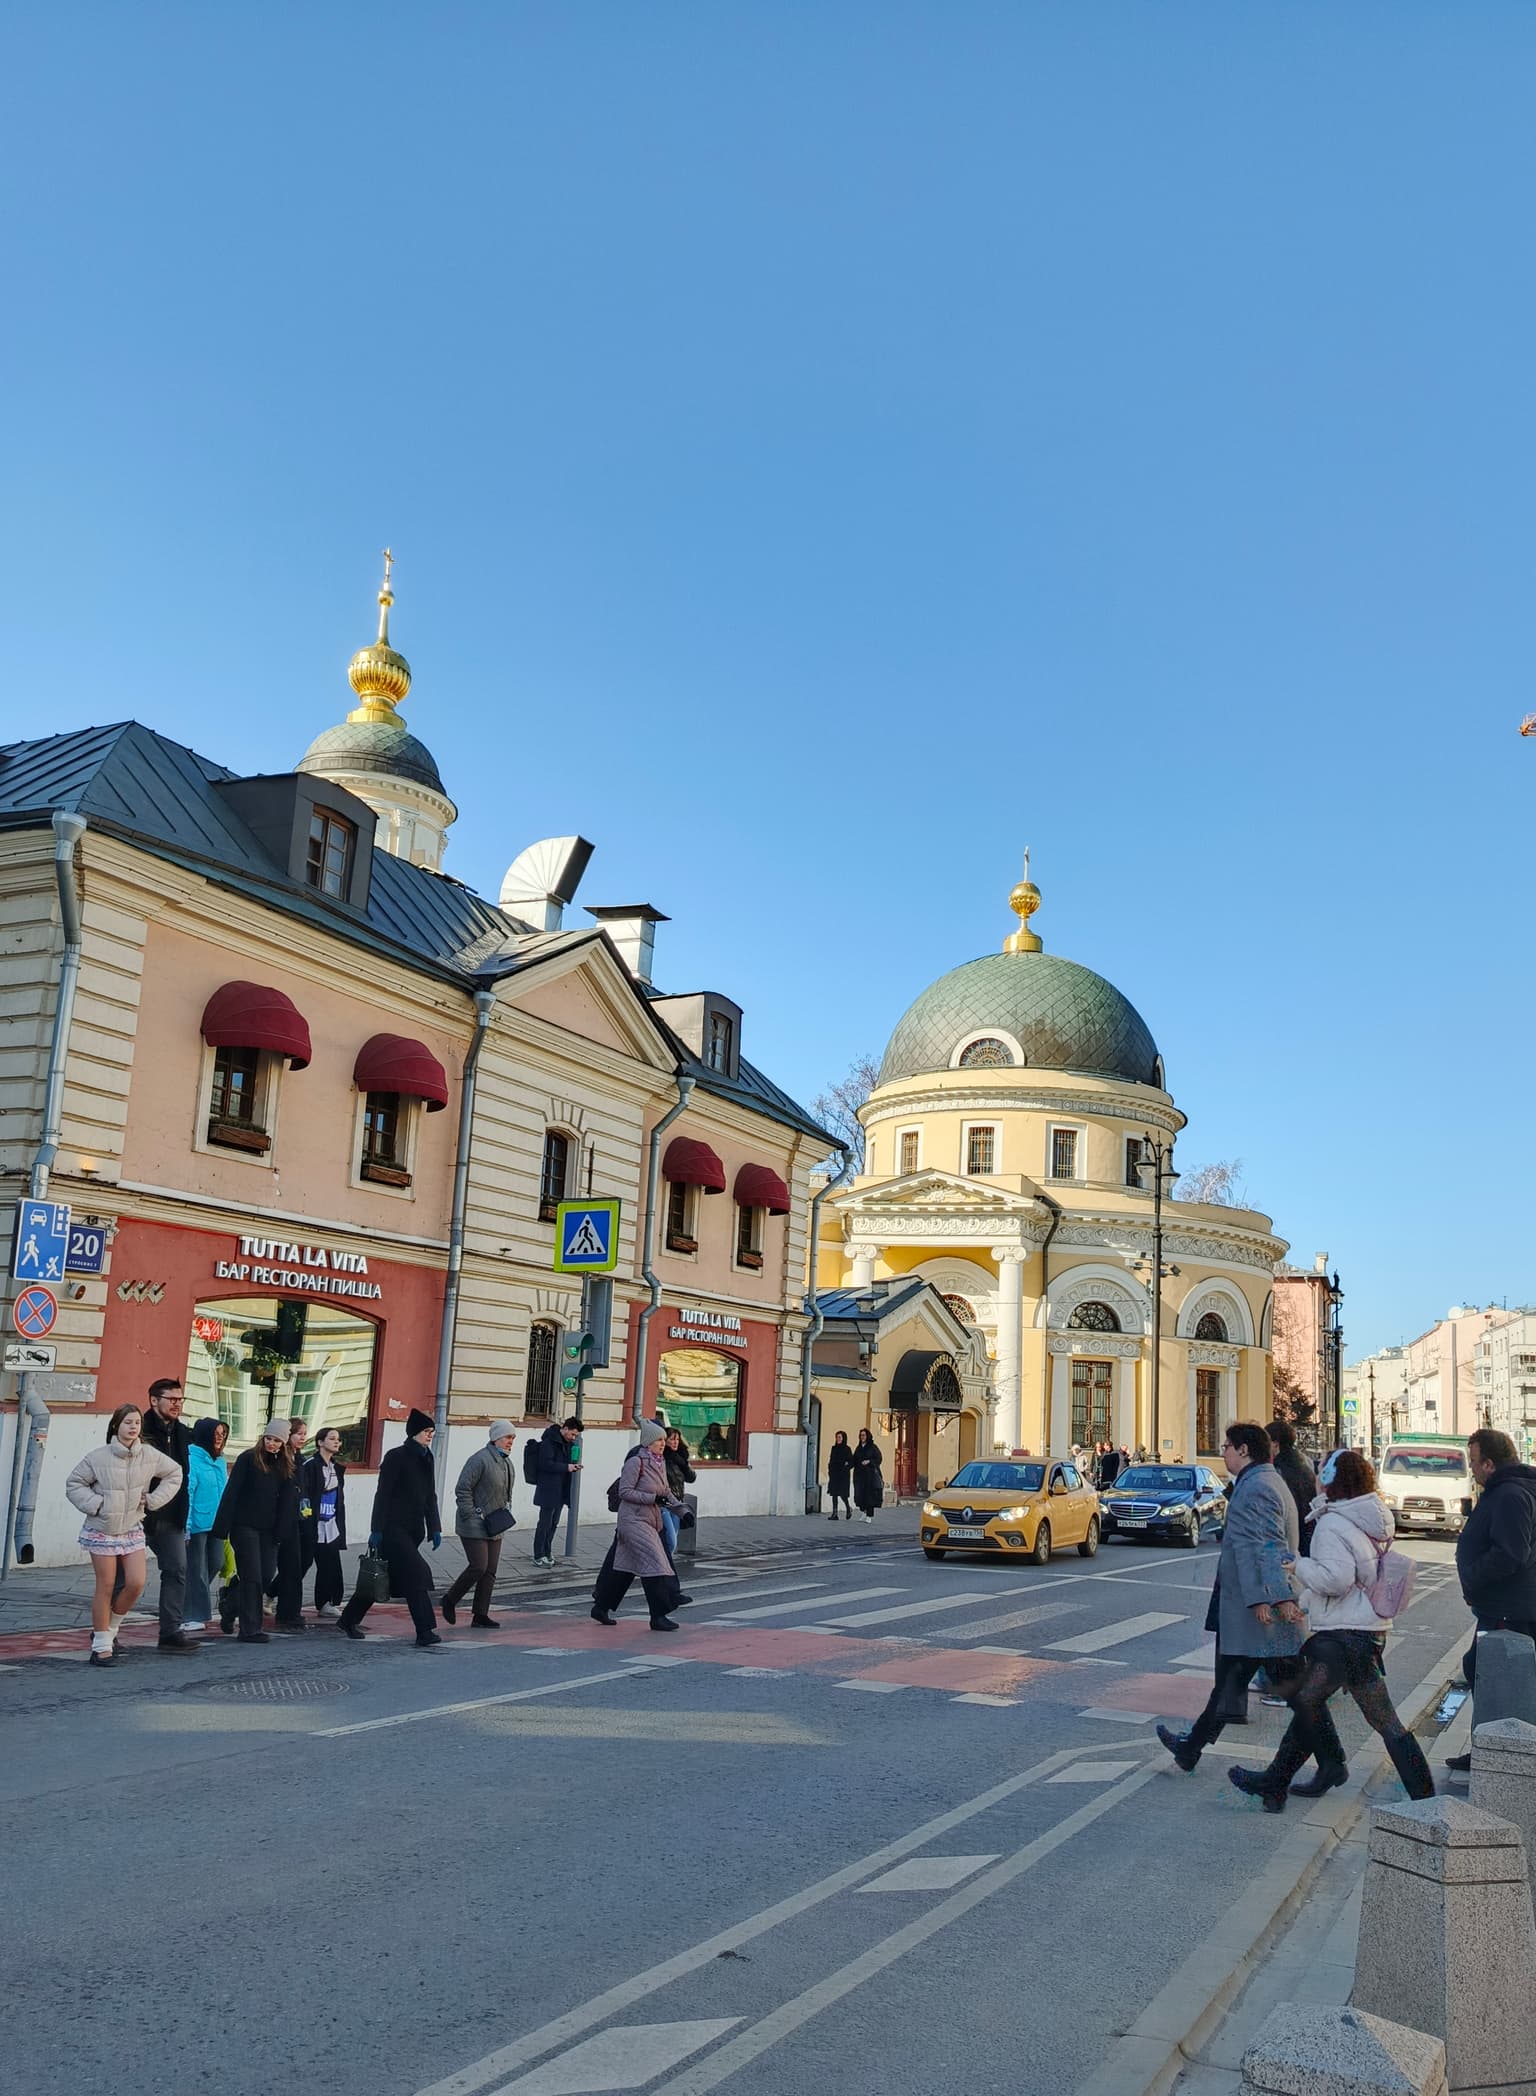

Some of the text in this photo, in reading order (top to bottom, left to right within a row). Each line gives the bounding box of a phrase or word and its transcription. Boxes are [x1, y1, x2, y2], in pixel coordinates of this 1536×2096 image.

[71, 1233, 99, 1257] 20
[240, 1235, 368, 1274] TUTTA LA VITA
[216, 1261, 382, 1299] БАР РЕСТОРАН ПИЦЦА
[680, 1309, 741, 1331] TUTTA LA VITA
[670, 1327, 748, 1348] БАР РЕСТОРАН ПИЦЦА
